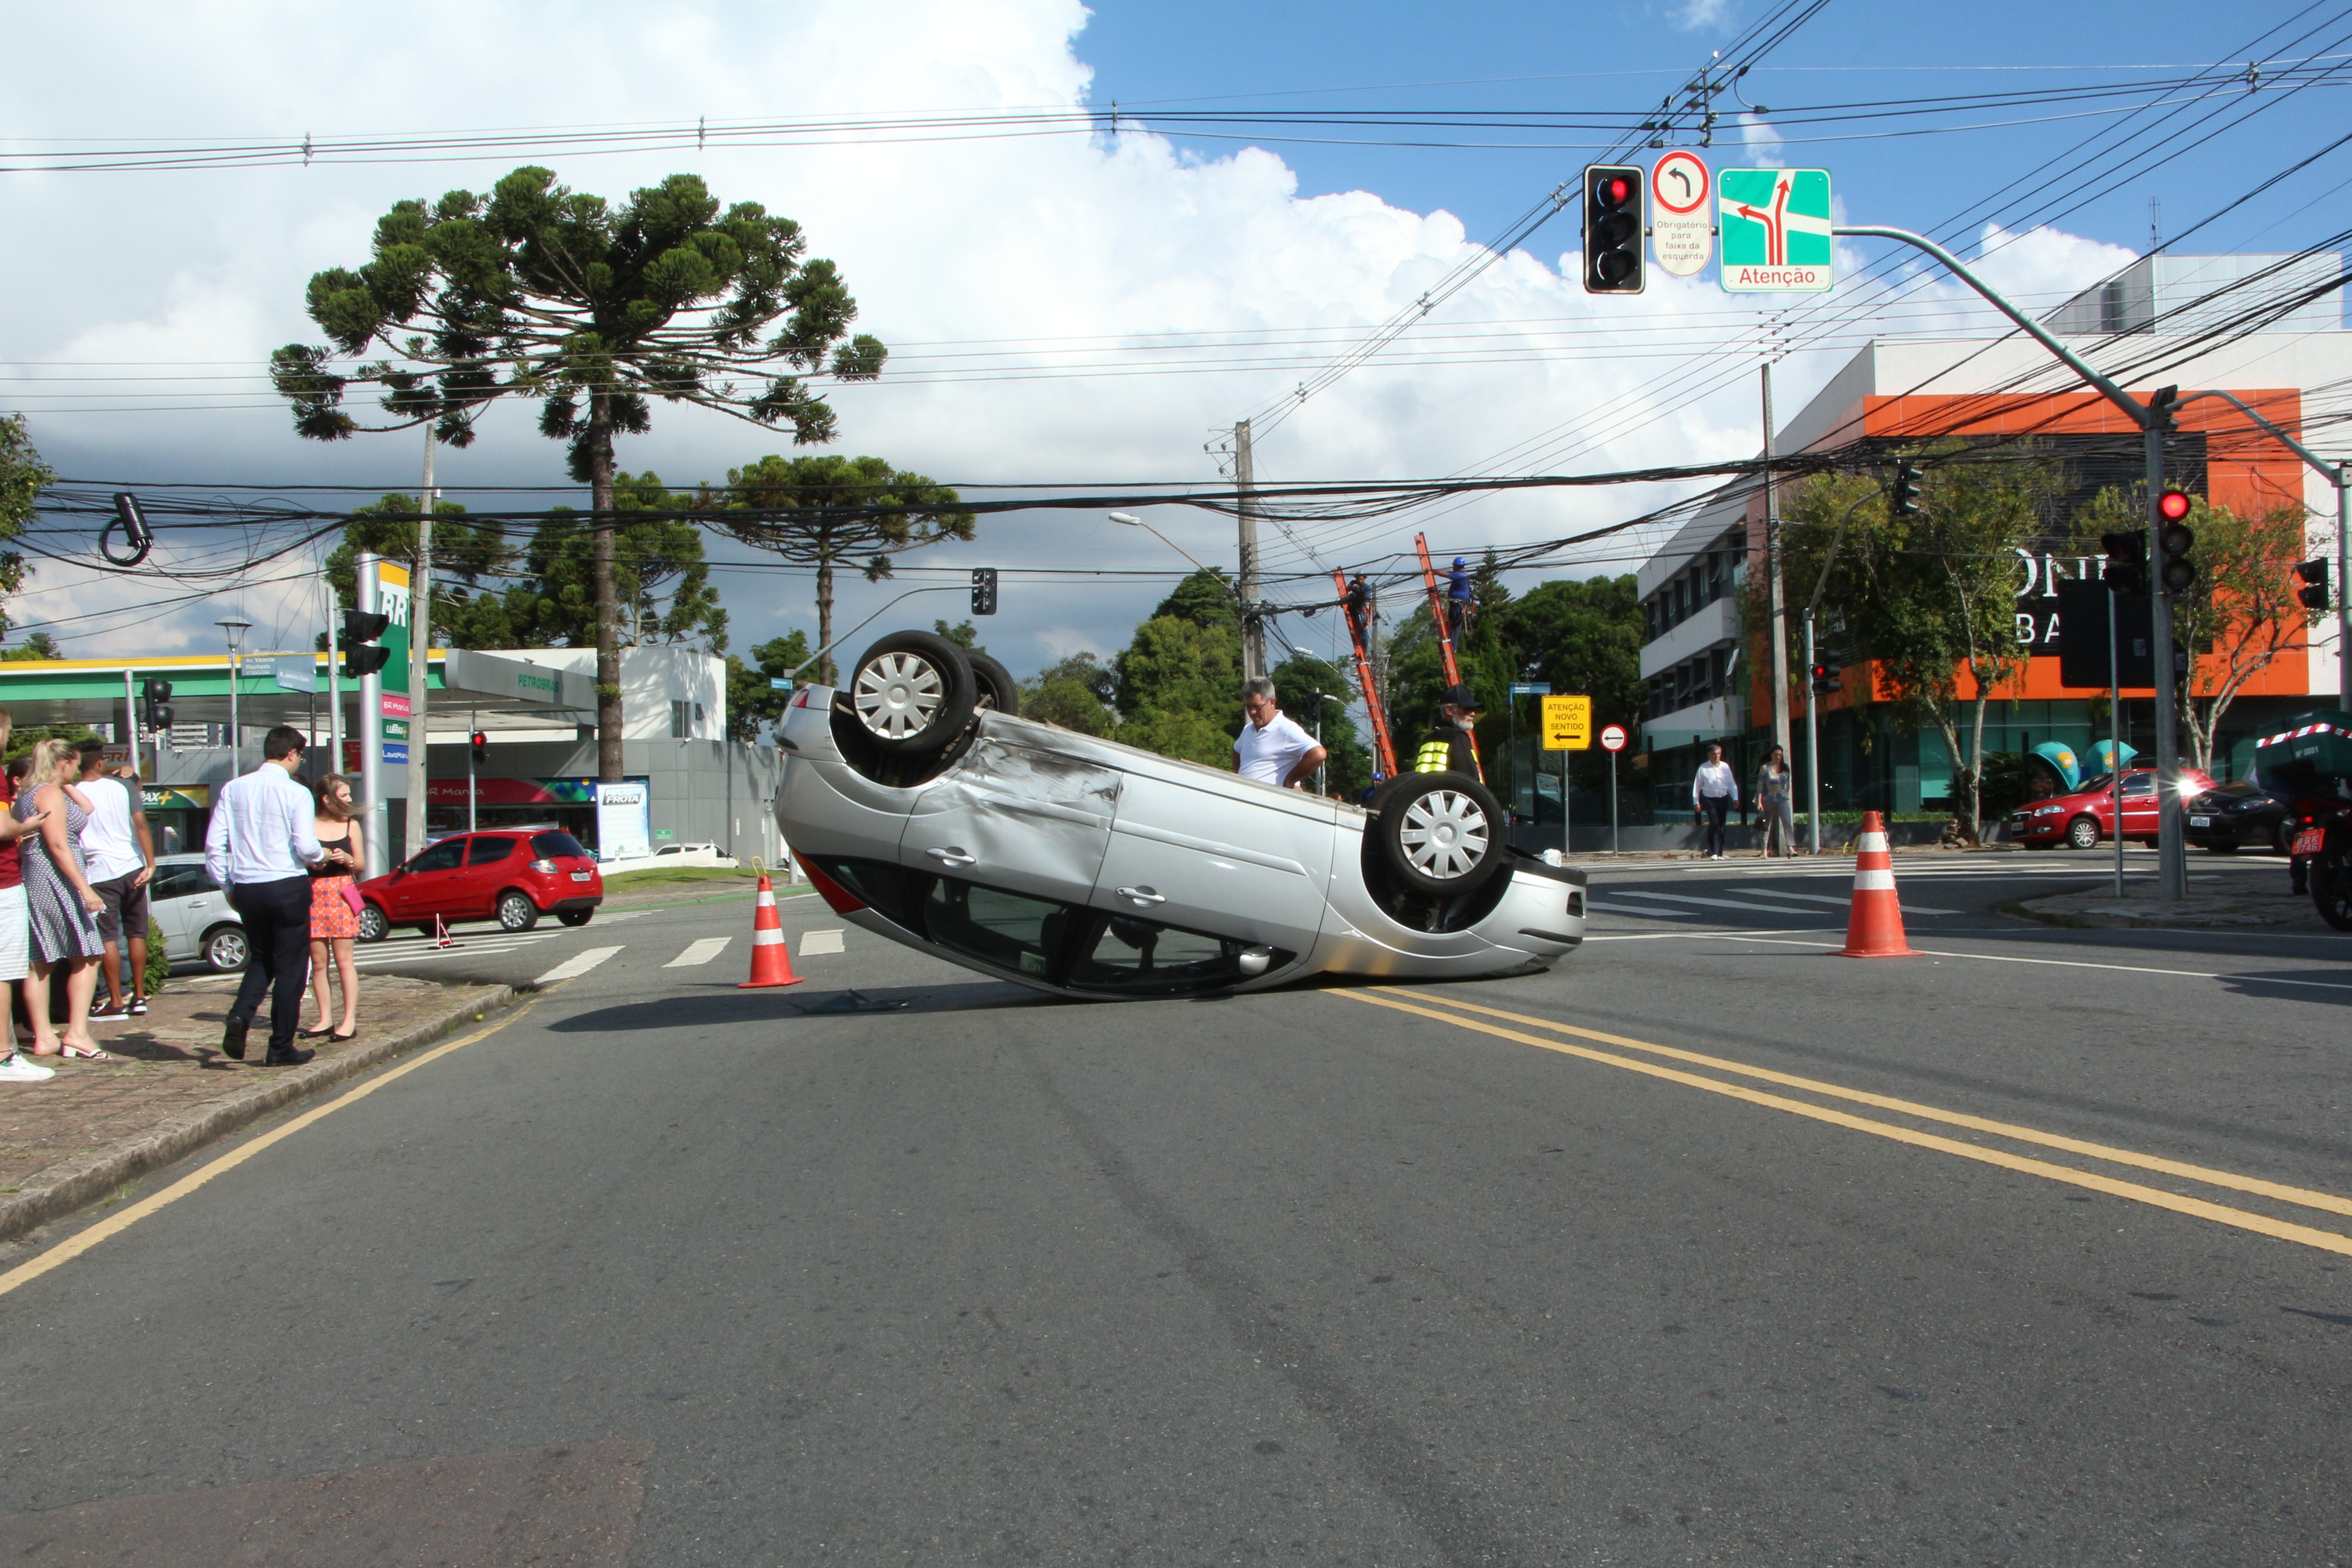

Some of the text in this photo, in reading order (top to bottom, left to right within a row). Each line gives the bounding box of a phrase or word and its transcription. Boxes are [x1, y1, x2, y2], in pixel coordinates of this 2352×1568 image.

[1656, 220, 1707, 230] Obrigatório
[1662, 253, 1704, 261] esquerda
[1739, 268, 1815, 287] Atenção
[382, 591, 407, 628] BR
[518, 674, 559, 693] PETROBRAS
[1548, 702, 1585, 712] ATENÇÃO
[2064, 756, 2072, 765] oi
[2105, 757, 2113, 765] oi
[606, 795, 639, 804] FROTA
